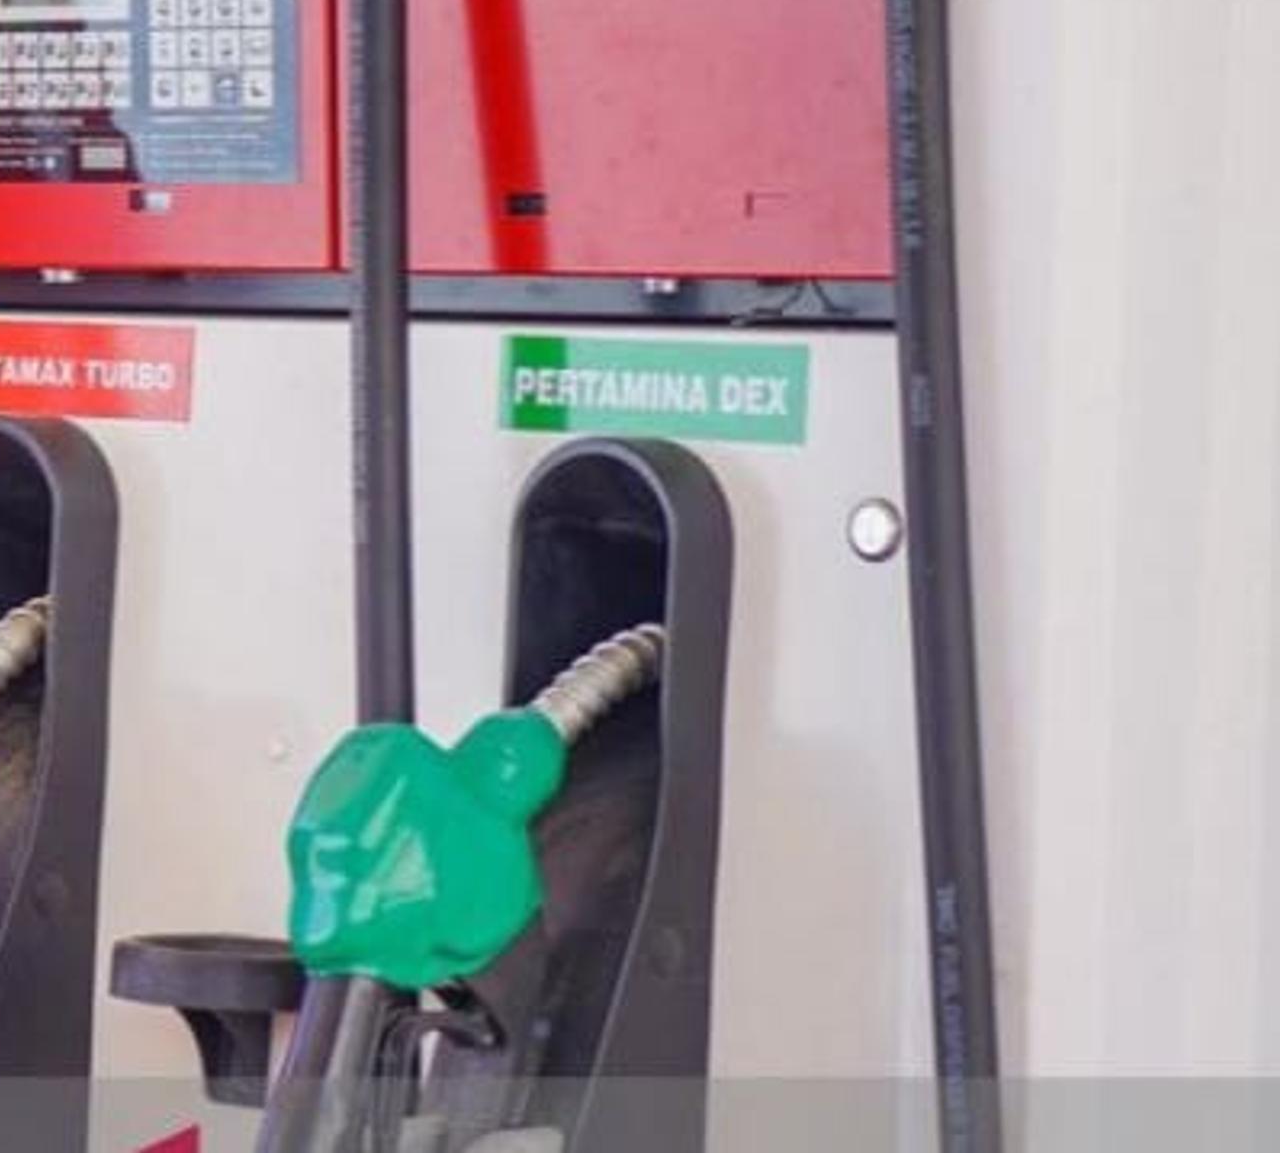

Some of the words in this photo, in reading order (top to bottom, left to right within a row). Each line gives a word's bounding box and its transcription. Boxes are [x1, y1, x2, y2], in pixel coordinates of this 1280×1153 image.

[85, 356, 176, 392] TURBO
[514, 368, 708, 414] PERTAMINA
[720, 376, 789, 416] DEX
